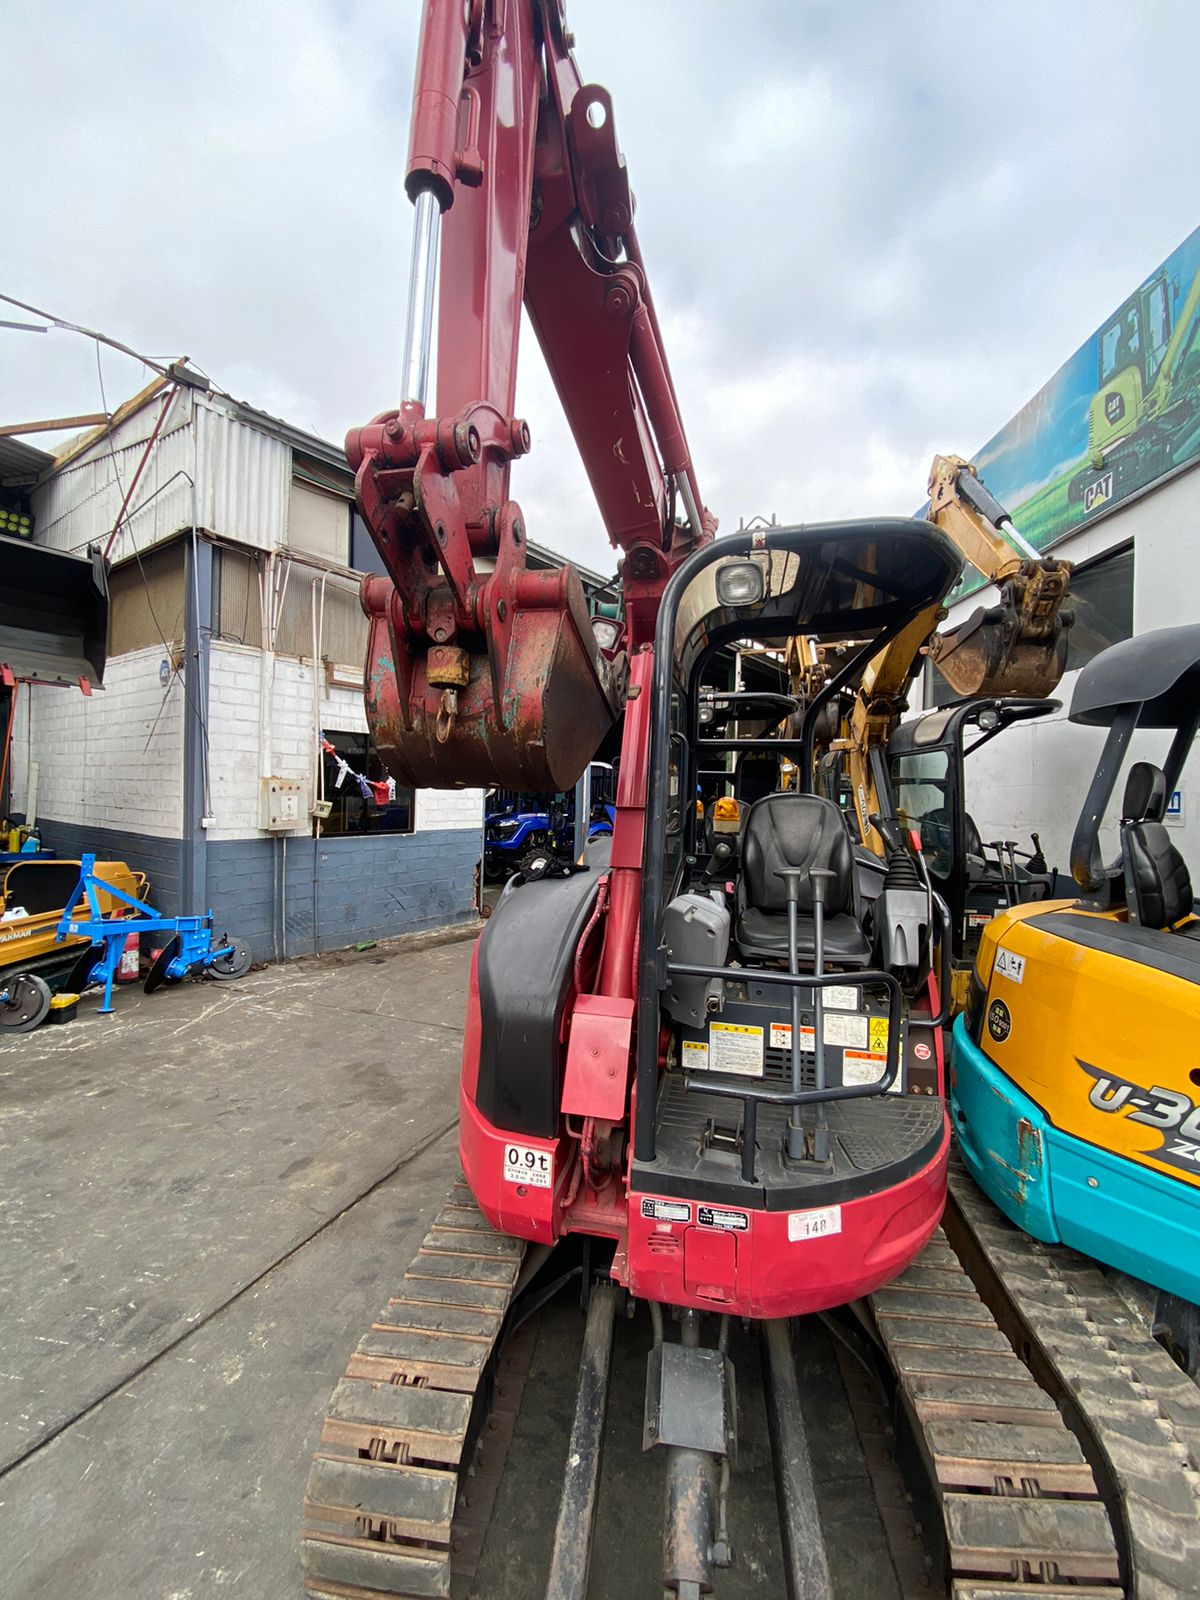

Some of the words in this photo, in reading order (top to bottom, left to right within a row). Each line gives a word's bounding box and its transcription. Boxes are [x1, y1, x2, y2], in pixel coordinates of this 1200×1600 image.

[1108, 395, 1120, 412] CAT
[1085, 474, 1112, 511] CAT
[805, 1219, 827, 1236] 148
